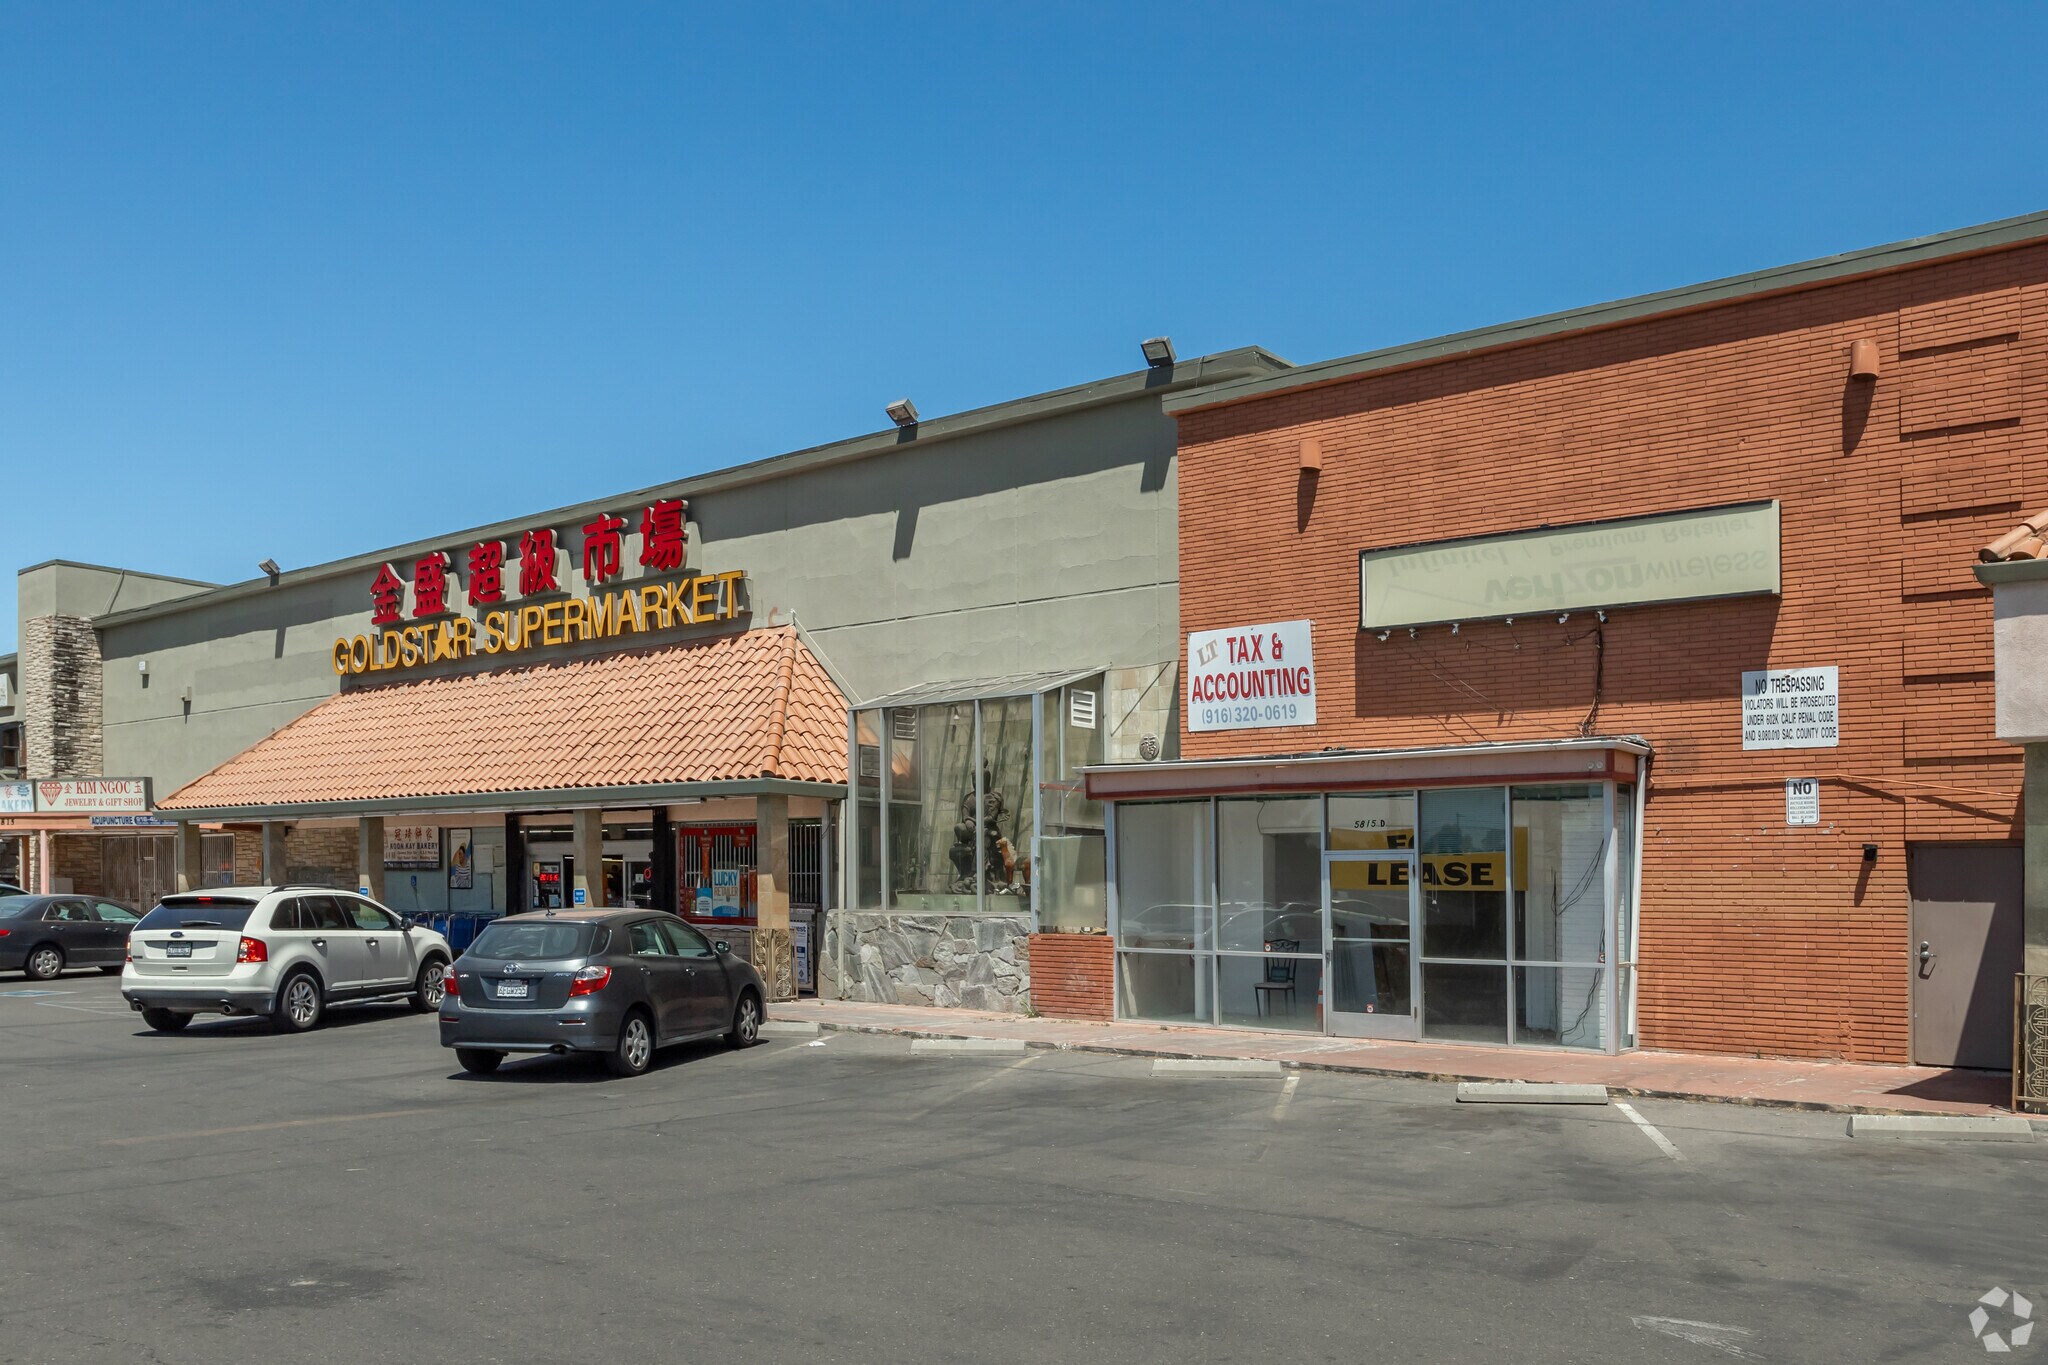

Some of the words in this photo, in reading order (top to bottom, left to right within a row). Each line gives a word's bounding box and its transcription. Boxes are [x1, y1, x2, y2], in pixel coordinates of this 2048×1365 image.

[484, 570, 746, 654] SUPERMARKET
[1196, 639, 1219, 667] LT
[1226, 633, 1264, 664] TAX
[1271, 632, 1284, 661] &
[1191, 666, 1311, 703] ACCOUNTING
[1755, 678, 1767, 694] NO
[1770, 675, 1825, 694] TRESPASSING
[1744, 698, 1773, 710] VIOLATORS
[1776, 697, 1788, 709] WILL
[1790, 696, 1798, 708] BE
[1800, 695, 1836, 708] PROSECUTED
[1201, 706, 1232, 724] (916)
[1234, 703, 1297, 723] 320-0619
[1746, 714, 1764, 726] UNDER
[1798, 711, 1816, 723] PENAL
[1818, 710, 1834, 723] CODE
[1745, 729, 1756, 741] AND
[1796, 727, 1819, 739] COUNTY
[1820, 726, 1836, 738] CODE
[76, 780, 97, 794] KIM
[99, 780, 131, 794] NGOC
[1793, 782, 1812, 795] NO
[64, 798, 97, 807] JEWELRY
[98, 798, 103, 806] &
[105, 798, 122, 806] GIFT
[123, 798, 144, 807] SHOP
[91, 816, 133, 825] ACUPUNCTURE
[1380, 819, 1386, 828] D
[405, 842, 415, 850] KAY
[417, 842, 438, 850] BAKERY
[713, 870, 738, 886] LUCKY
[1367, 861, 1494, 886] LEASE
